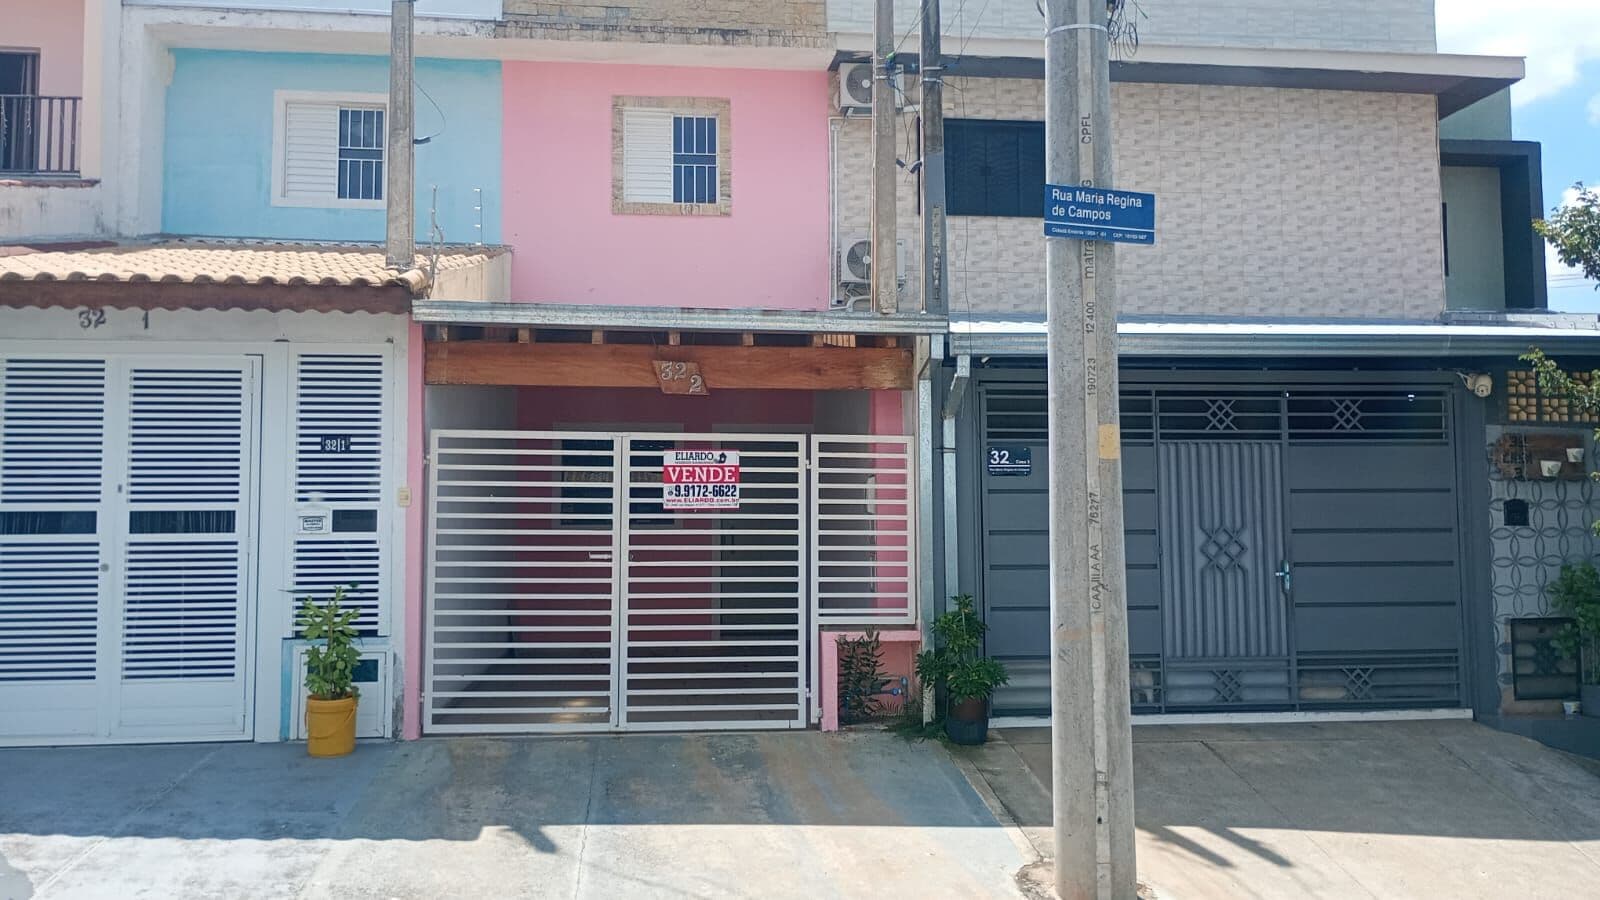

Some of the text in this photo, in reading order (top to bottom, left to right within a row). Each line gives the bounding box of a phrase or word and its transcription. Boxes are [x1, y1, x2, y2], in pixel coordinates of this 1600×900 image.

[1081, 112, 1092, 144] CPFL
[1052, 188, 1142, 209] Rua Maria Regina
[1051, 204, 1111, 221] de Campos
[79, 308, 106, 329] 32
[661, 361, 702, 393] 32 2
[1086, 357, 1096, 396] 190723
[675, 451, 714, 461] ELIARDO
[990, 450, 1010, 465] 32
[667, 466, 736, 482] VENDE
[674, 485, 737, 497] 9.9172-6622
